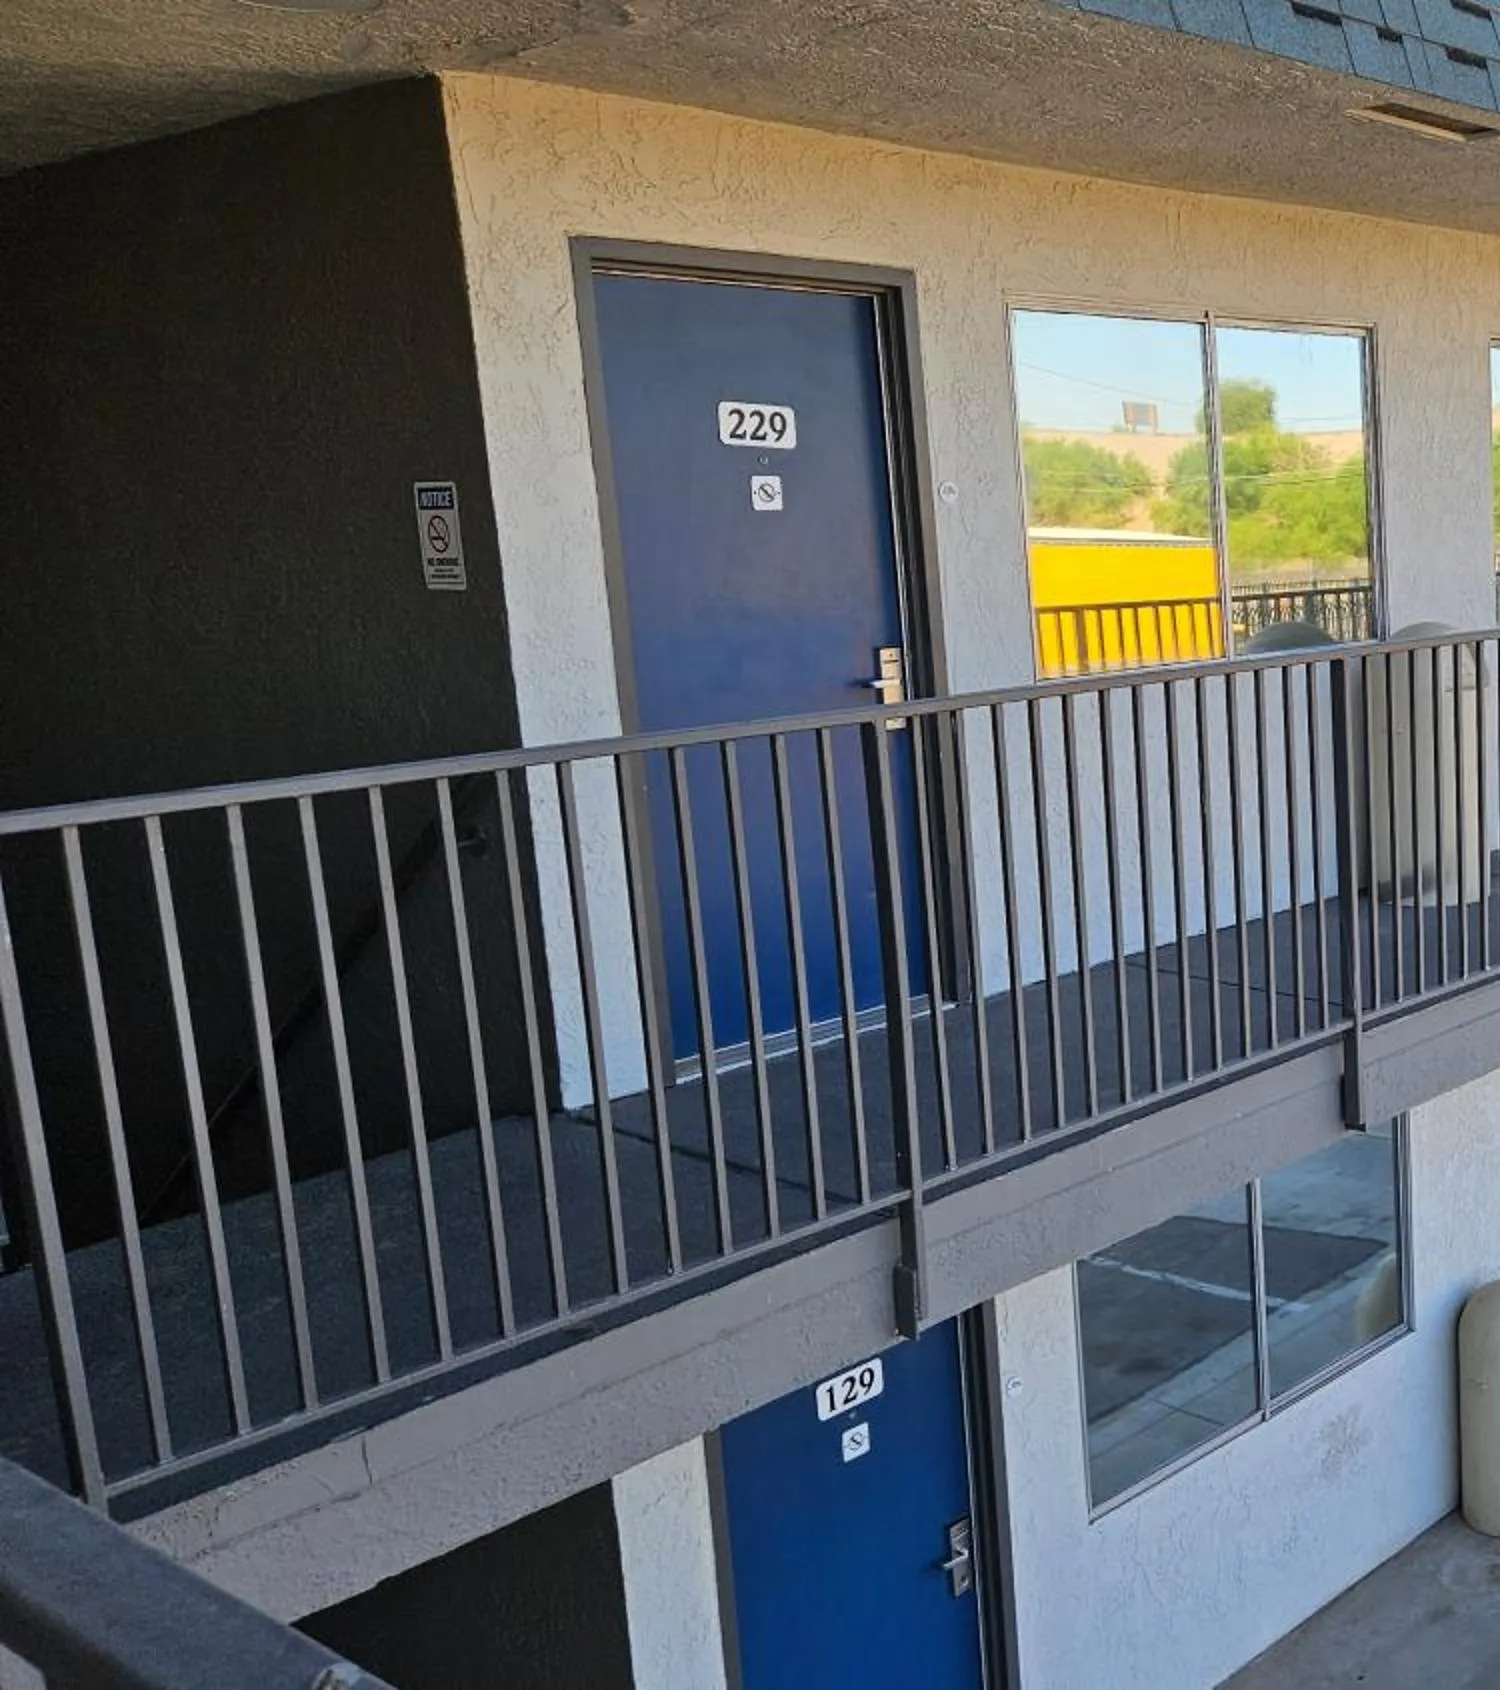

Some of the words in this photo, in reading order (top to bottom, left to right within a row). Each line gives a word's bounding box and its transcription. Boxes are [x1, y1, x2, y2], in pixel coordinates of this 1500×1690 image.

[728, 408, 787, 442] 229
[419, 490, 453, 508] NOTICE
[826, 1367, 875, 1413] 129
